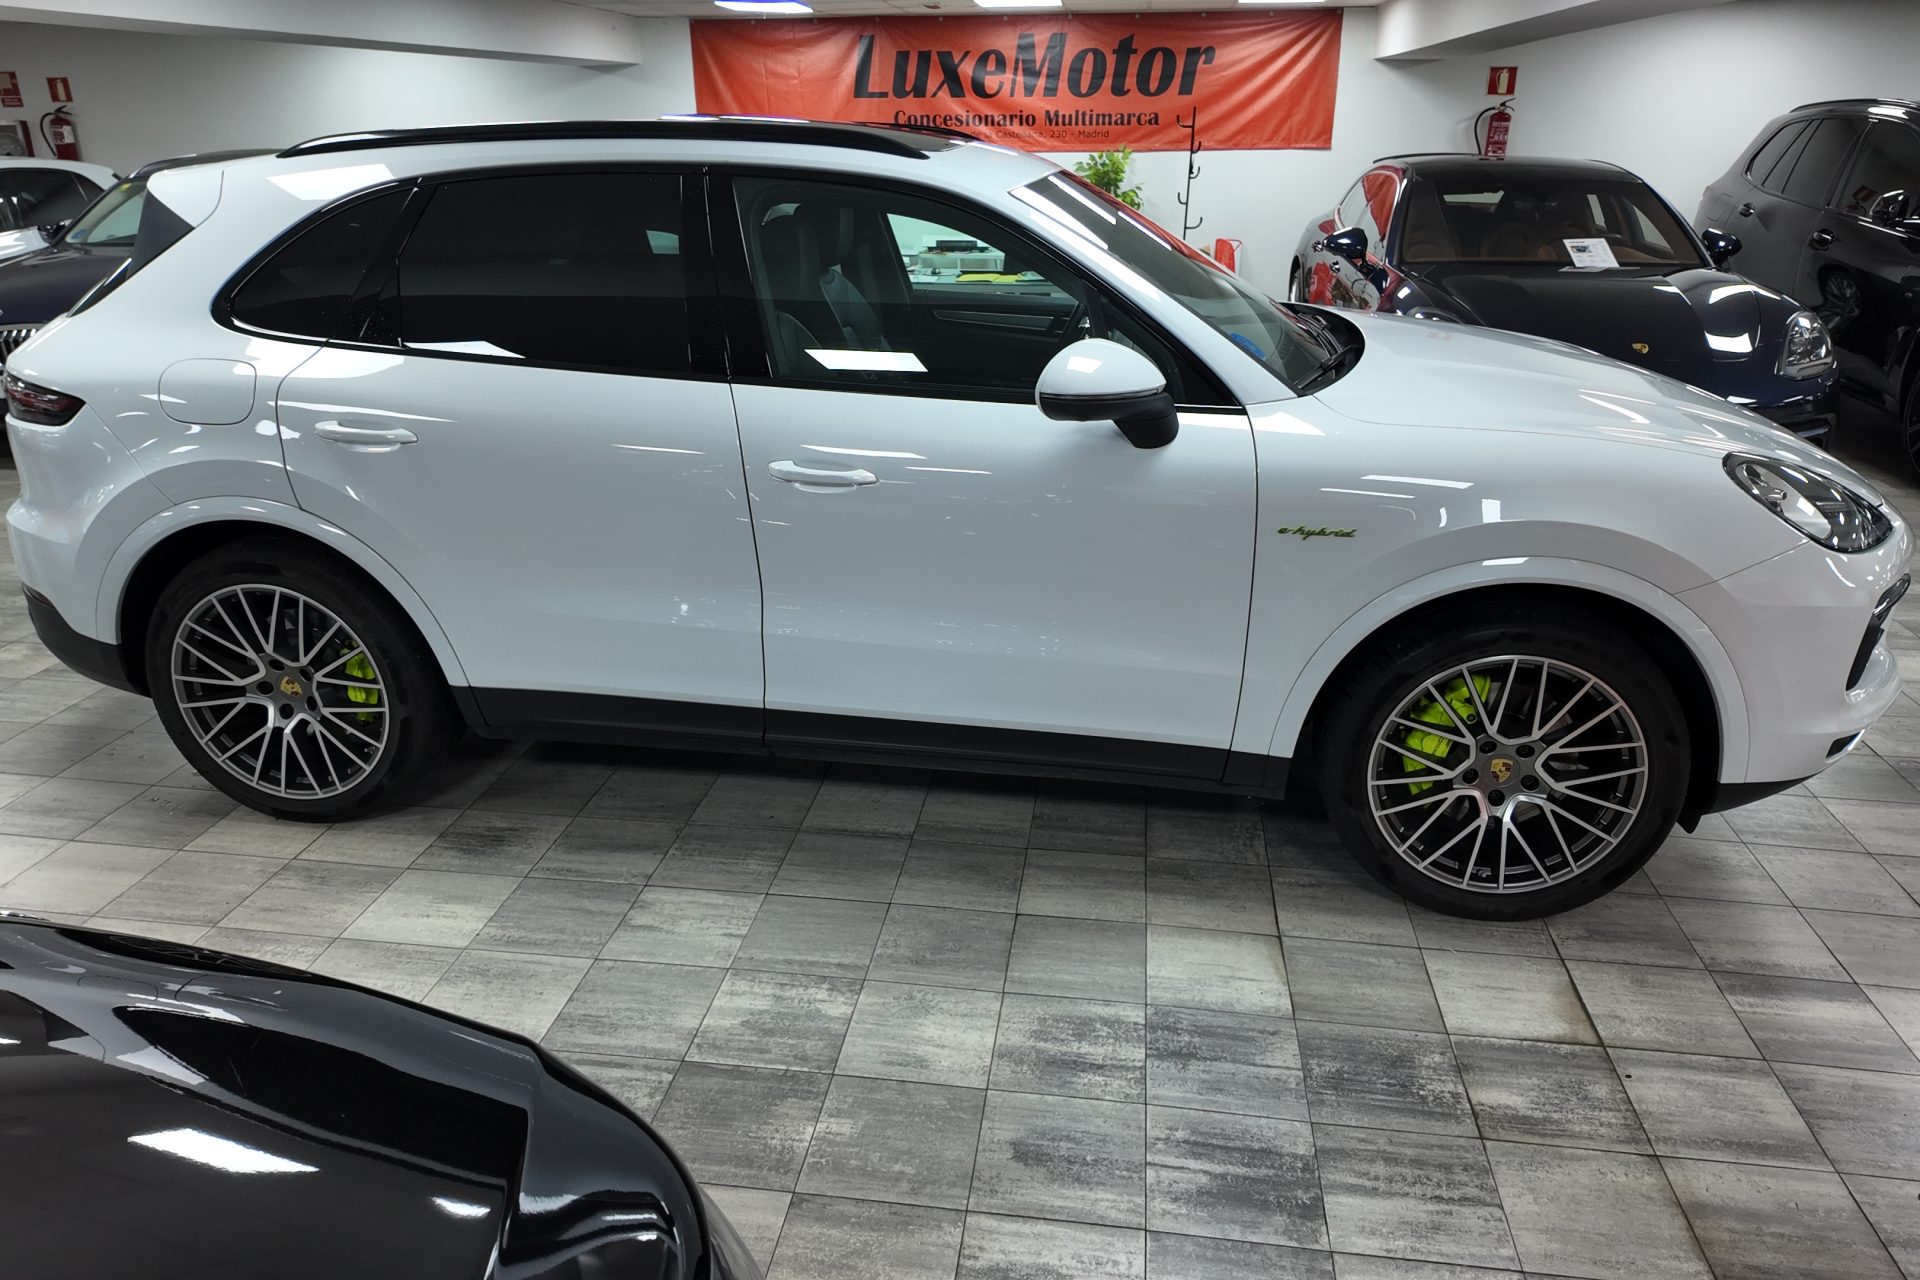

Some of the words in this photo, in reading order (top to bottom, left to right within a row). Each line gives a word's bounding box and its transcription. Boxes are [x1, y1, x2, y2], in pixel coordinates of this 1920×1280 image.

[853, 32, 1217, 99] LuxeMotor
[894, 109, 1037, 128] Concesionario
[1044, 109, 1160, 127] Multimarca
[1049, 130, 1067, 138] 230
[1078, 129, 1110, 138] Madrid
